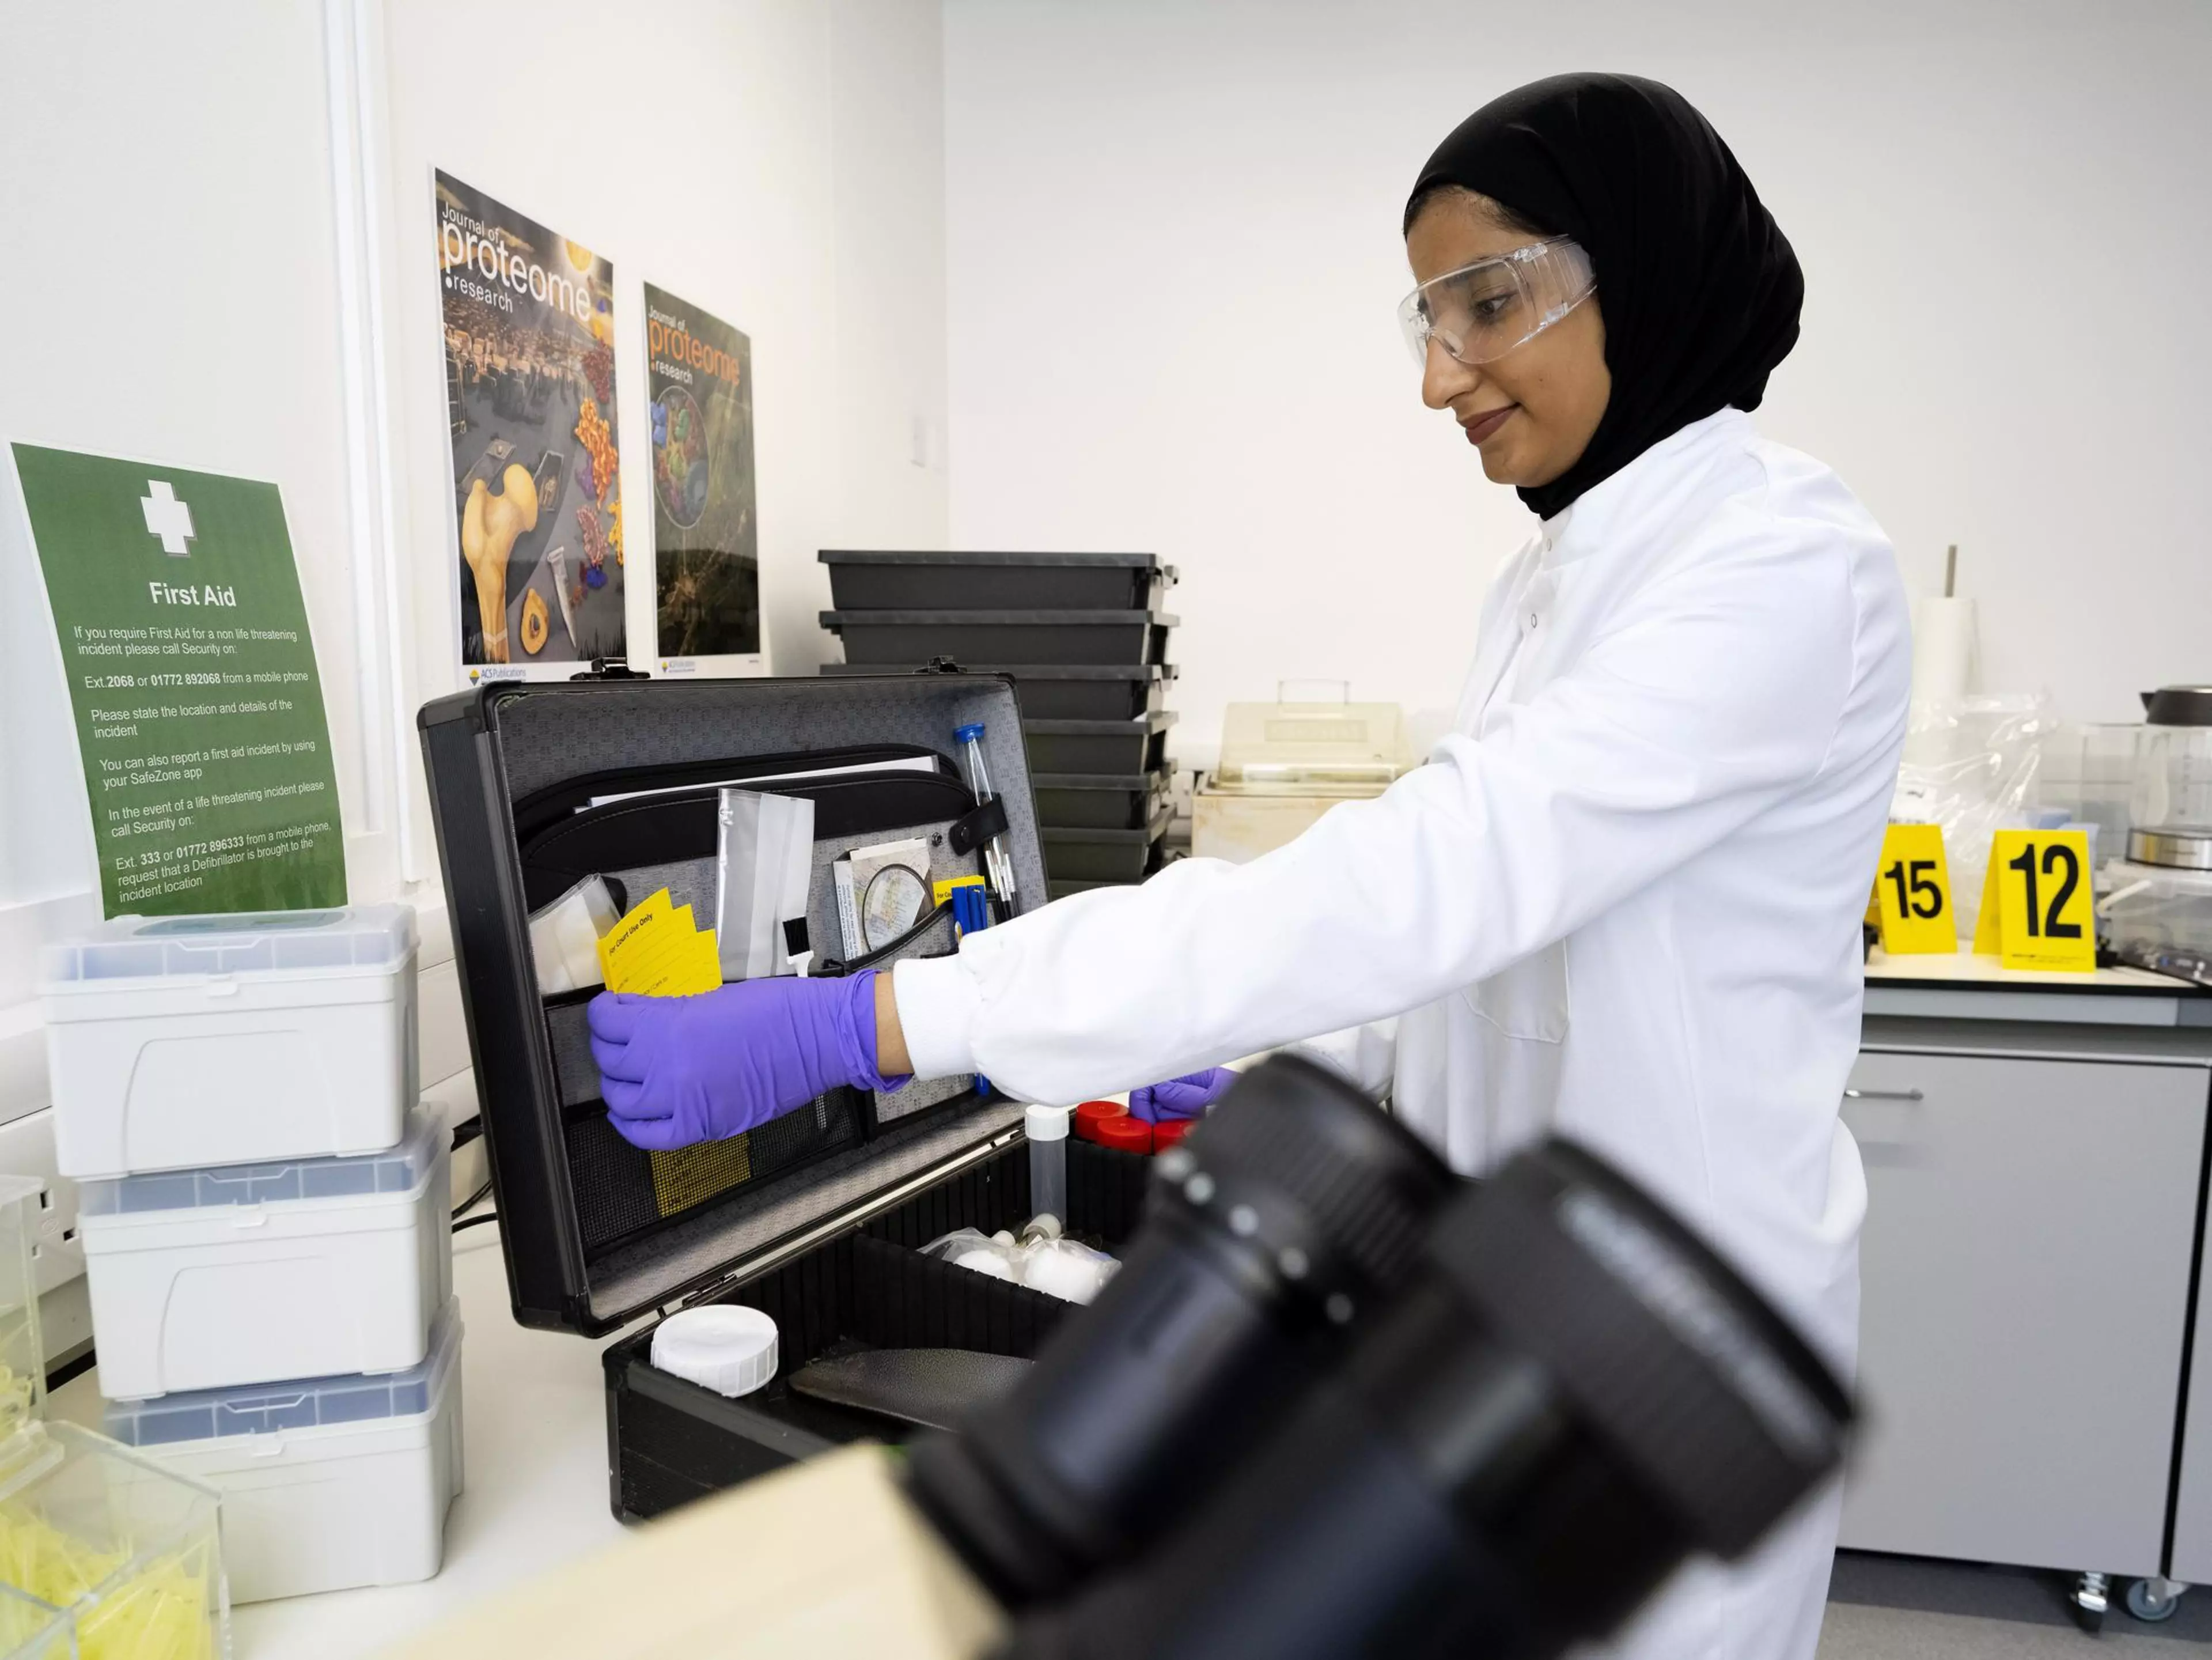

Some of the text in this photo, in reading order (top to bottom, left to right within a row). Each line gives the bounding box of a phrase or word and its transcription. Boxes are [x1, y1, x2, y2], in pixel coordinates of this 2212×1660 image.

[442, 201, 499, 244] Journal of
[443, 220, 591, 322] proteome
[649, 319, 740, 387] proteome
[149, 582, 236, 606] First Aid
[74, 626, 297, 642] If you require First Aid for a non life threatening
[78, 642, 237, 656] incident please call Security on:
[138, 677, 148, 686] or
[151, 674, 183, 686] 01772
[185, 673, 221, 685] 892068
[222, 672, 244, 683] from
[245, 674, 251, 683] a
[253, 672, 281, 682] mobile
[283, 671, 308, 684] phone
[91, 699, 293, 721] Please state the location and details of the
[94, 724, 138, 738] incident
[100, 740, 316, 771] You can also report a first aid incident by using
[103, 768, 202, 791] your SafeZone app
[108, 781, 324, 820] In the event of a life threatening incident please
[111, 815, 195, 837] call Security on:
[116, 856, 137, 870] Ext.
[141, 851, 160, 865] 333
[163, 852, 174, 861] or
[176, 844, 207, 858] 01772
[210, 836, 244, 852] 896333
[247, 834, 266, 845] from
[268, 833, 274, 841] a
[275, 826, 302, 839] mobile
[118, 838, 313, 887] request that a Defibrillator is brought to the
[119, 876, 203, 903] incident location
[1884, 860, 1942, 919] 15
[2009, 844, 2082, 939] 12
[616, 931, 629, 947] Court
[629, 924, 639, 934] Use
[639, 913, 653, 925] Only
